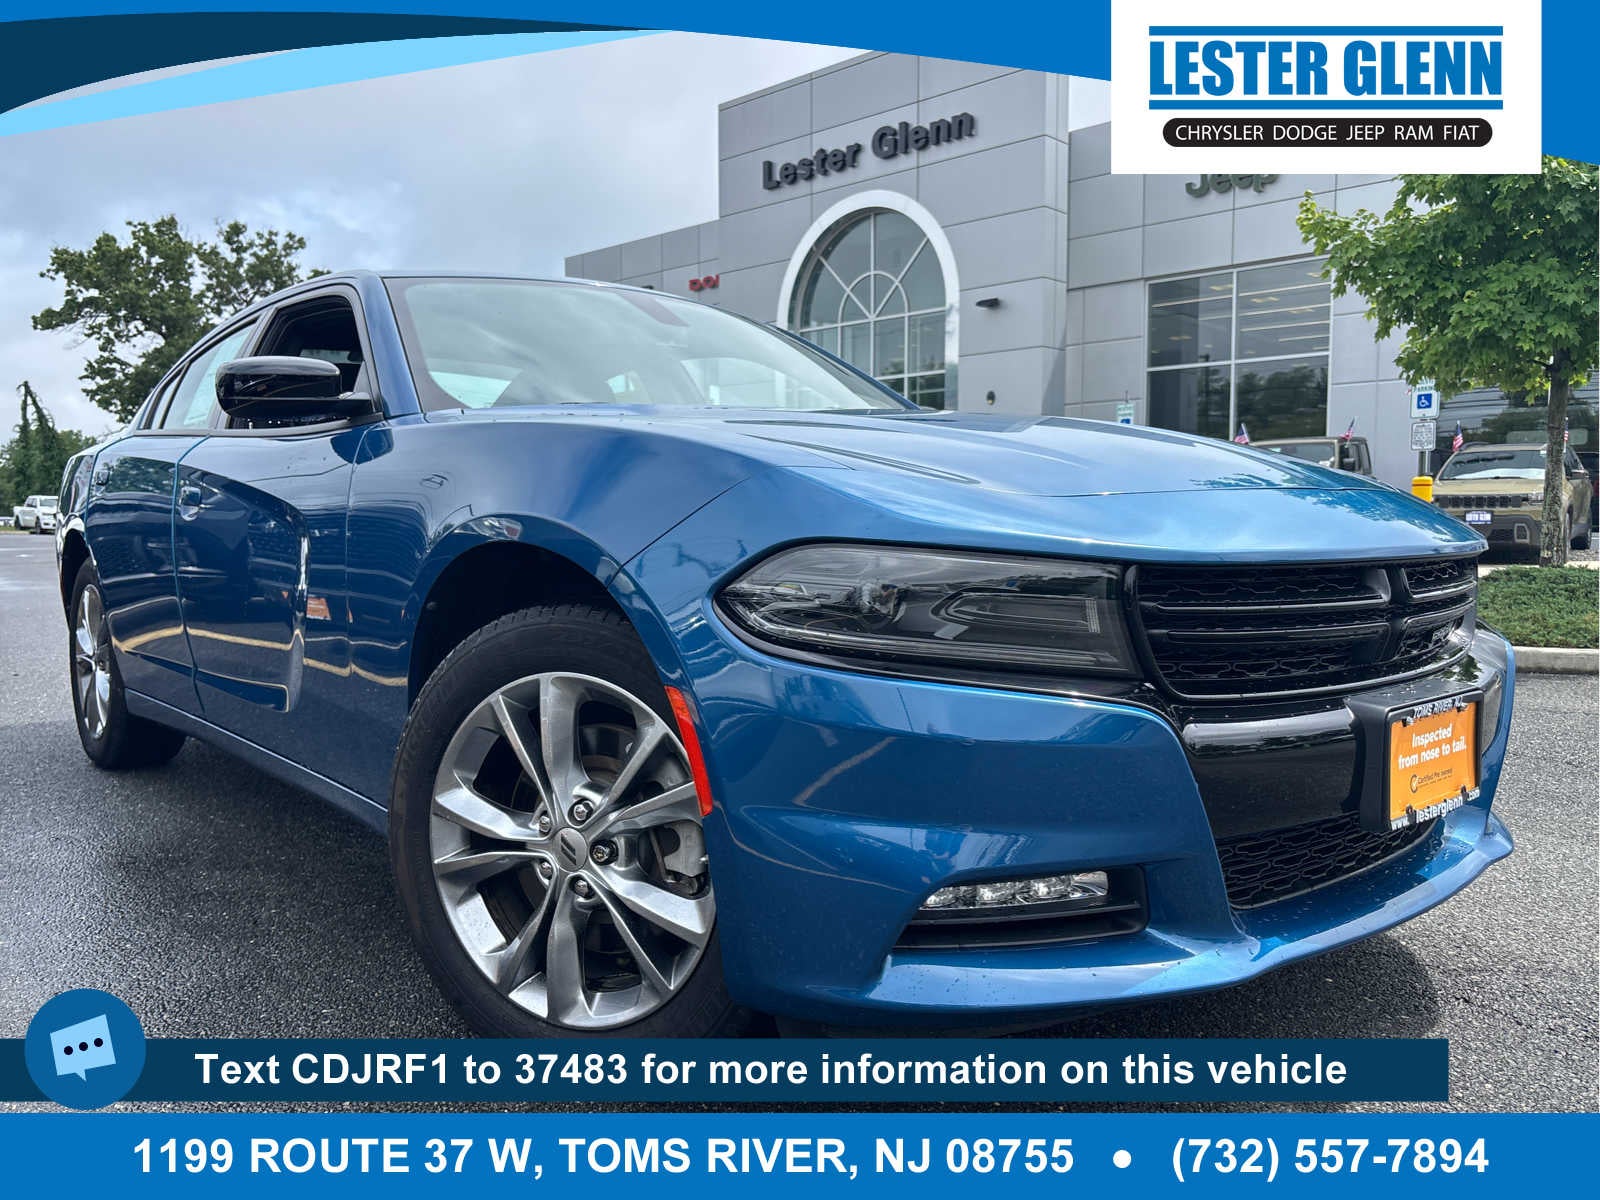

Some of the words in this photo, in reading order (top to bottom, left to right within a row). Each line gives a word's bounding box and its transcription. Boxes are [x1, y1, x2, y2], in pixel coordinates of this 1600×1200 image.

[762, 143, 862, 190] Lester
[872, 112, 976, 160] Glenn
[1413, 703, 1433, 719] TOMS
[1412, 723, 1453, 748] Inspected
[1398, 753, 1419, 769] from
[1420, 747, 1440, 762] nose
[1441, 743, 1451, 755] to
[1452, 736, 1467, 752] tail.
